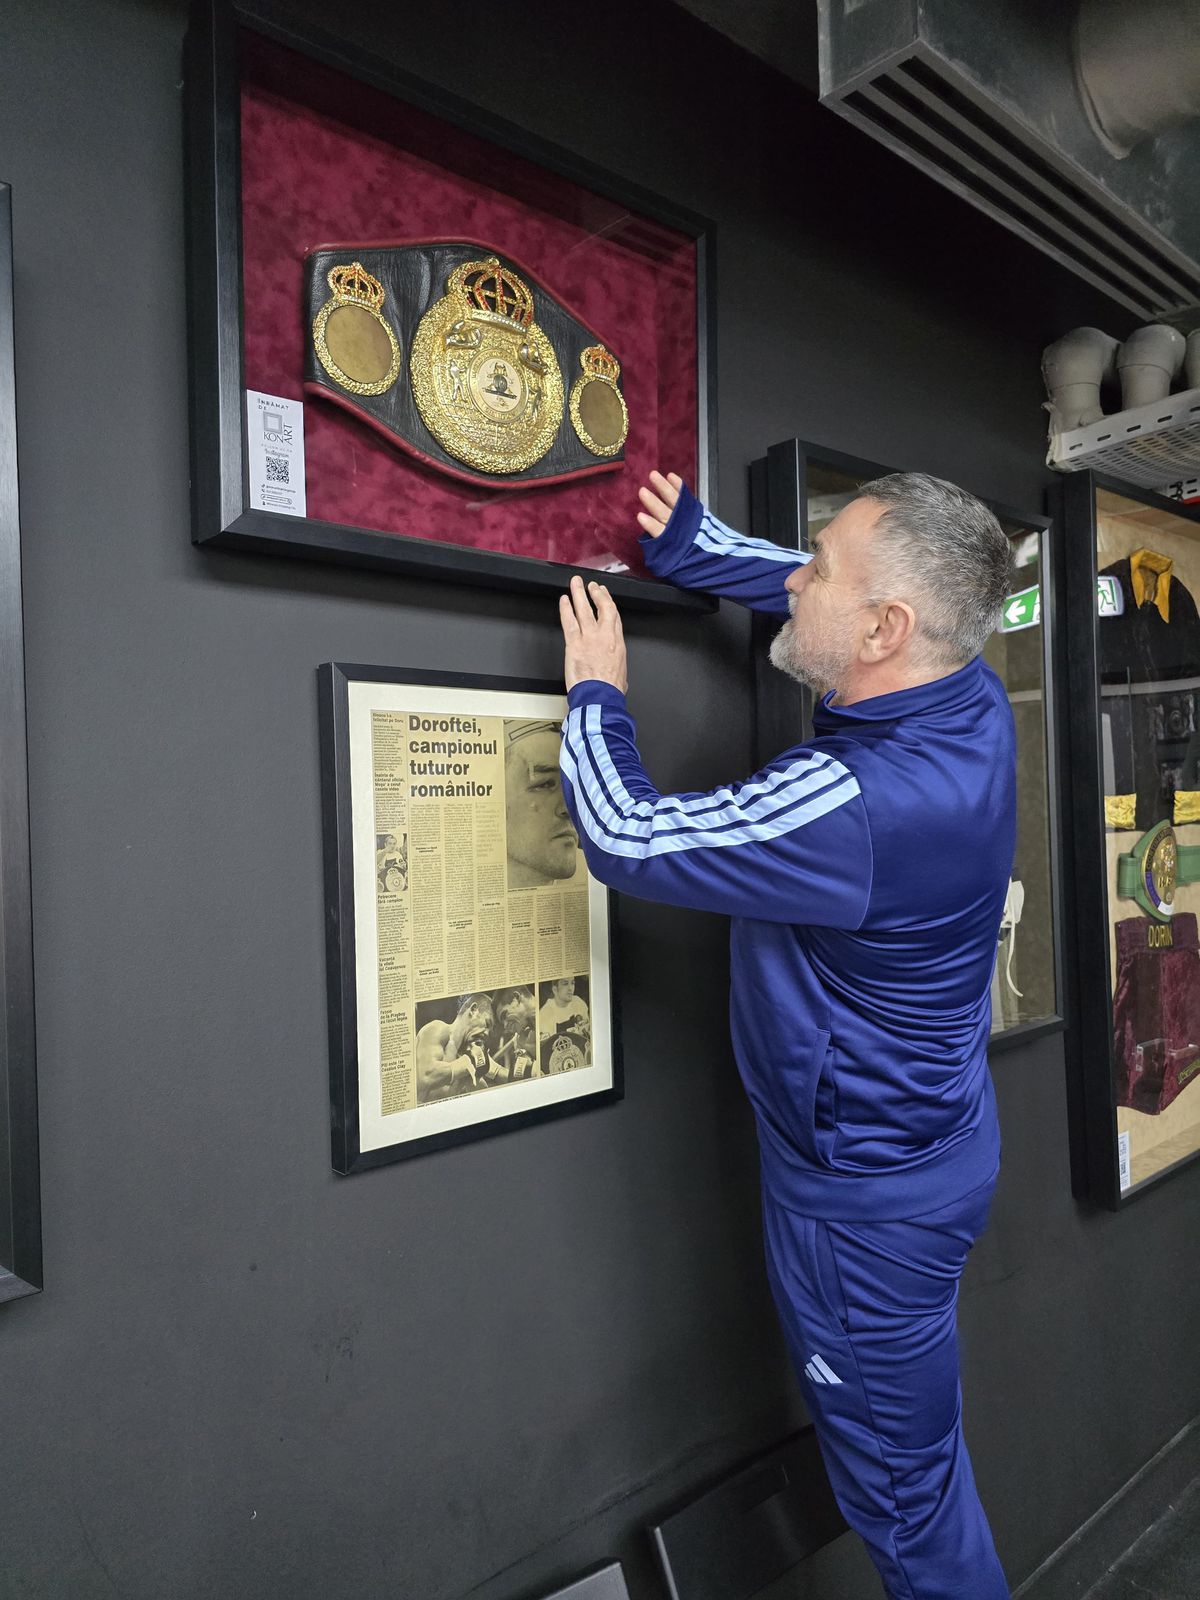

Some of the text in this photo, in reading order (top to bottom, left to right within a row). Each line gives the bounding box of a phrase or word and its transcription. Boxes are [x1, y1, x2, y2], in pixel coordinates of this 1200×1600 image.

[264, 432, 284, 444] KON
[283, 424, 293, 445] ART
[409, 715, 482, 736] Doroftei,
[409, 739, 497, 758] campionul
[409, 760, 470, 776] tuturor
[410, 780, 492, 797] românilor
[1148, 925, 1172, 948] DORIN
